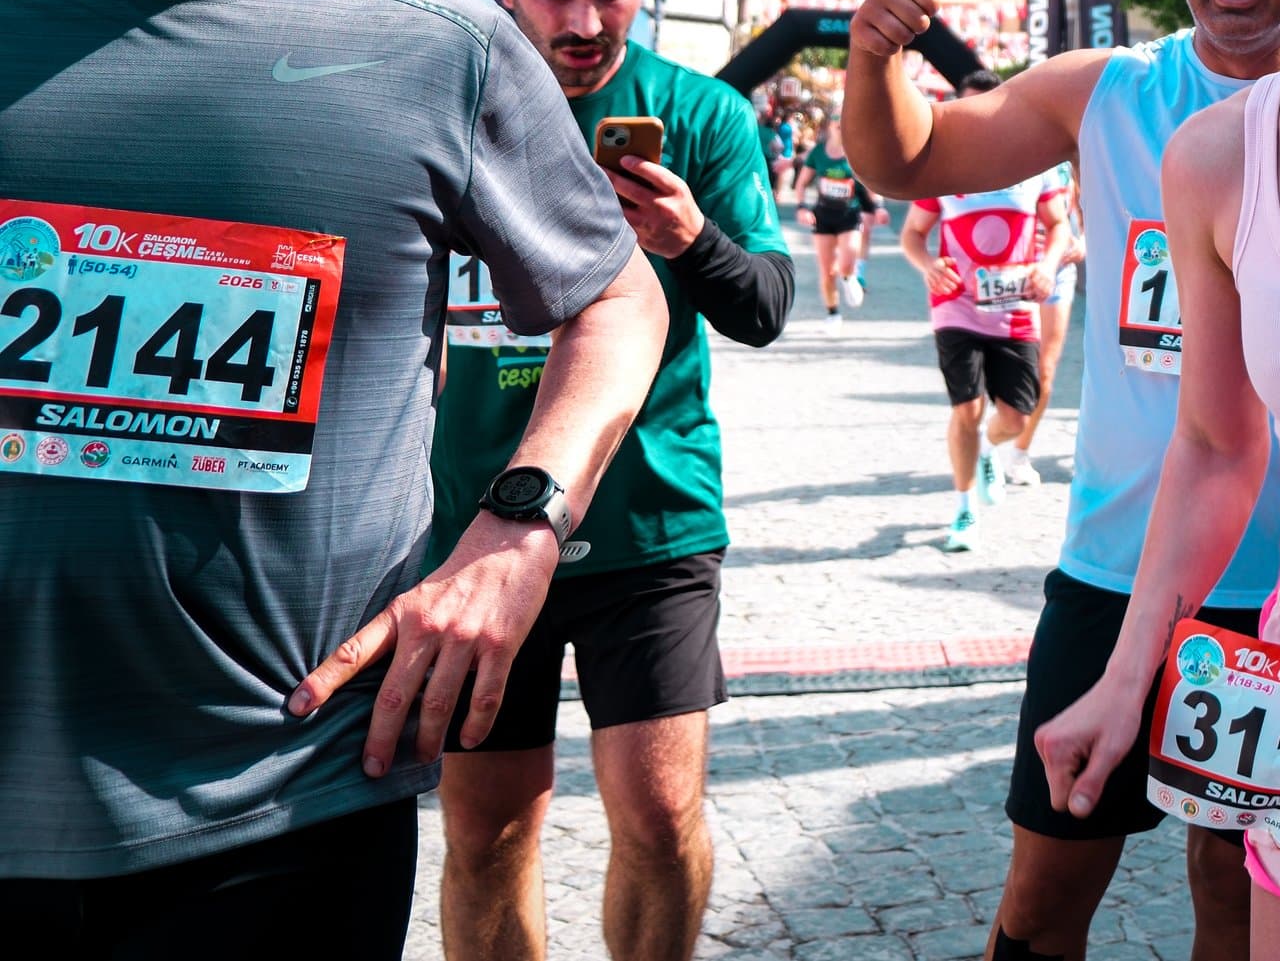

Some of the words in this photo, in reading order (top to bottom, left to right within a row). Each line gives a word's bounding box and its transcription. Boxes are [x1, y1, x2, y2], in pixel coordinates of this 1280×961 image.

[143, 233, 197, 245] SALOMON
[138, 241, 207, 261] ÇEŞME
[78, 261, 138, 279] (50-54)
[218, 274, 264, 289] 2026
[0, 287, 277, 403] 2144
[36, 403, 221, 440] SALOMON
[121, 455, 178, 469] GARMIN
[250, 462, 289, 472] ACADEMY
